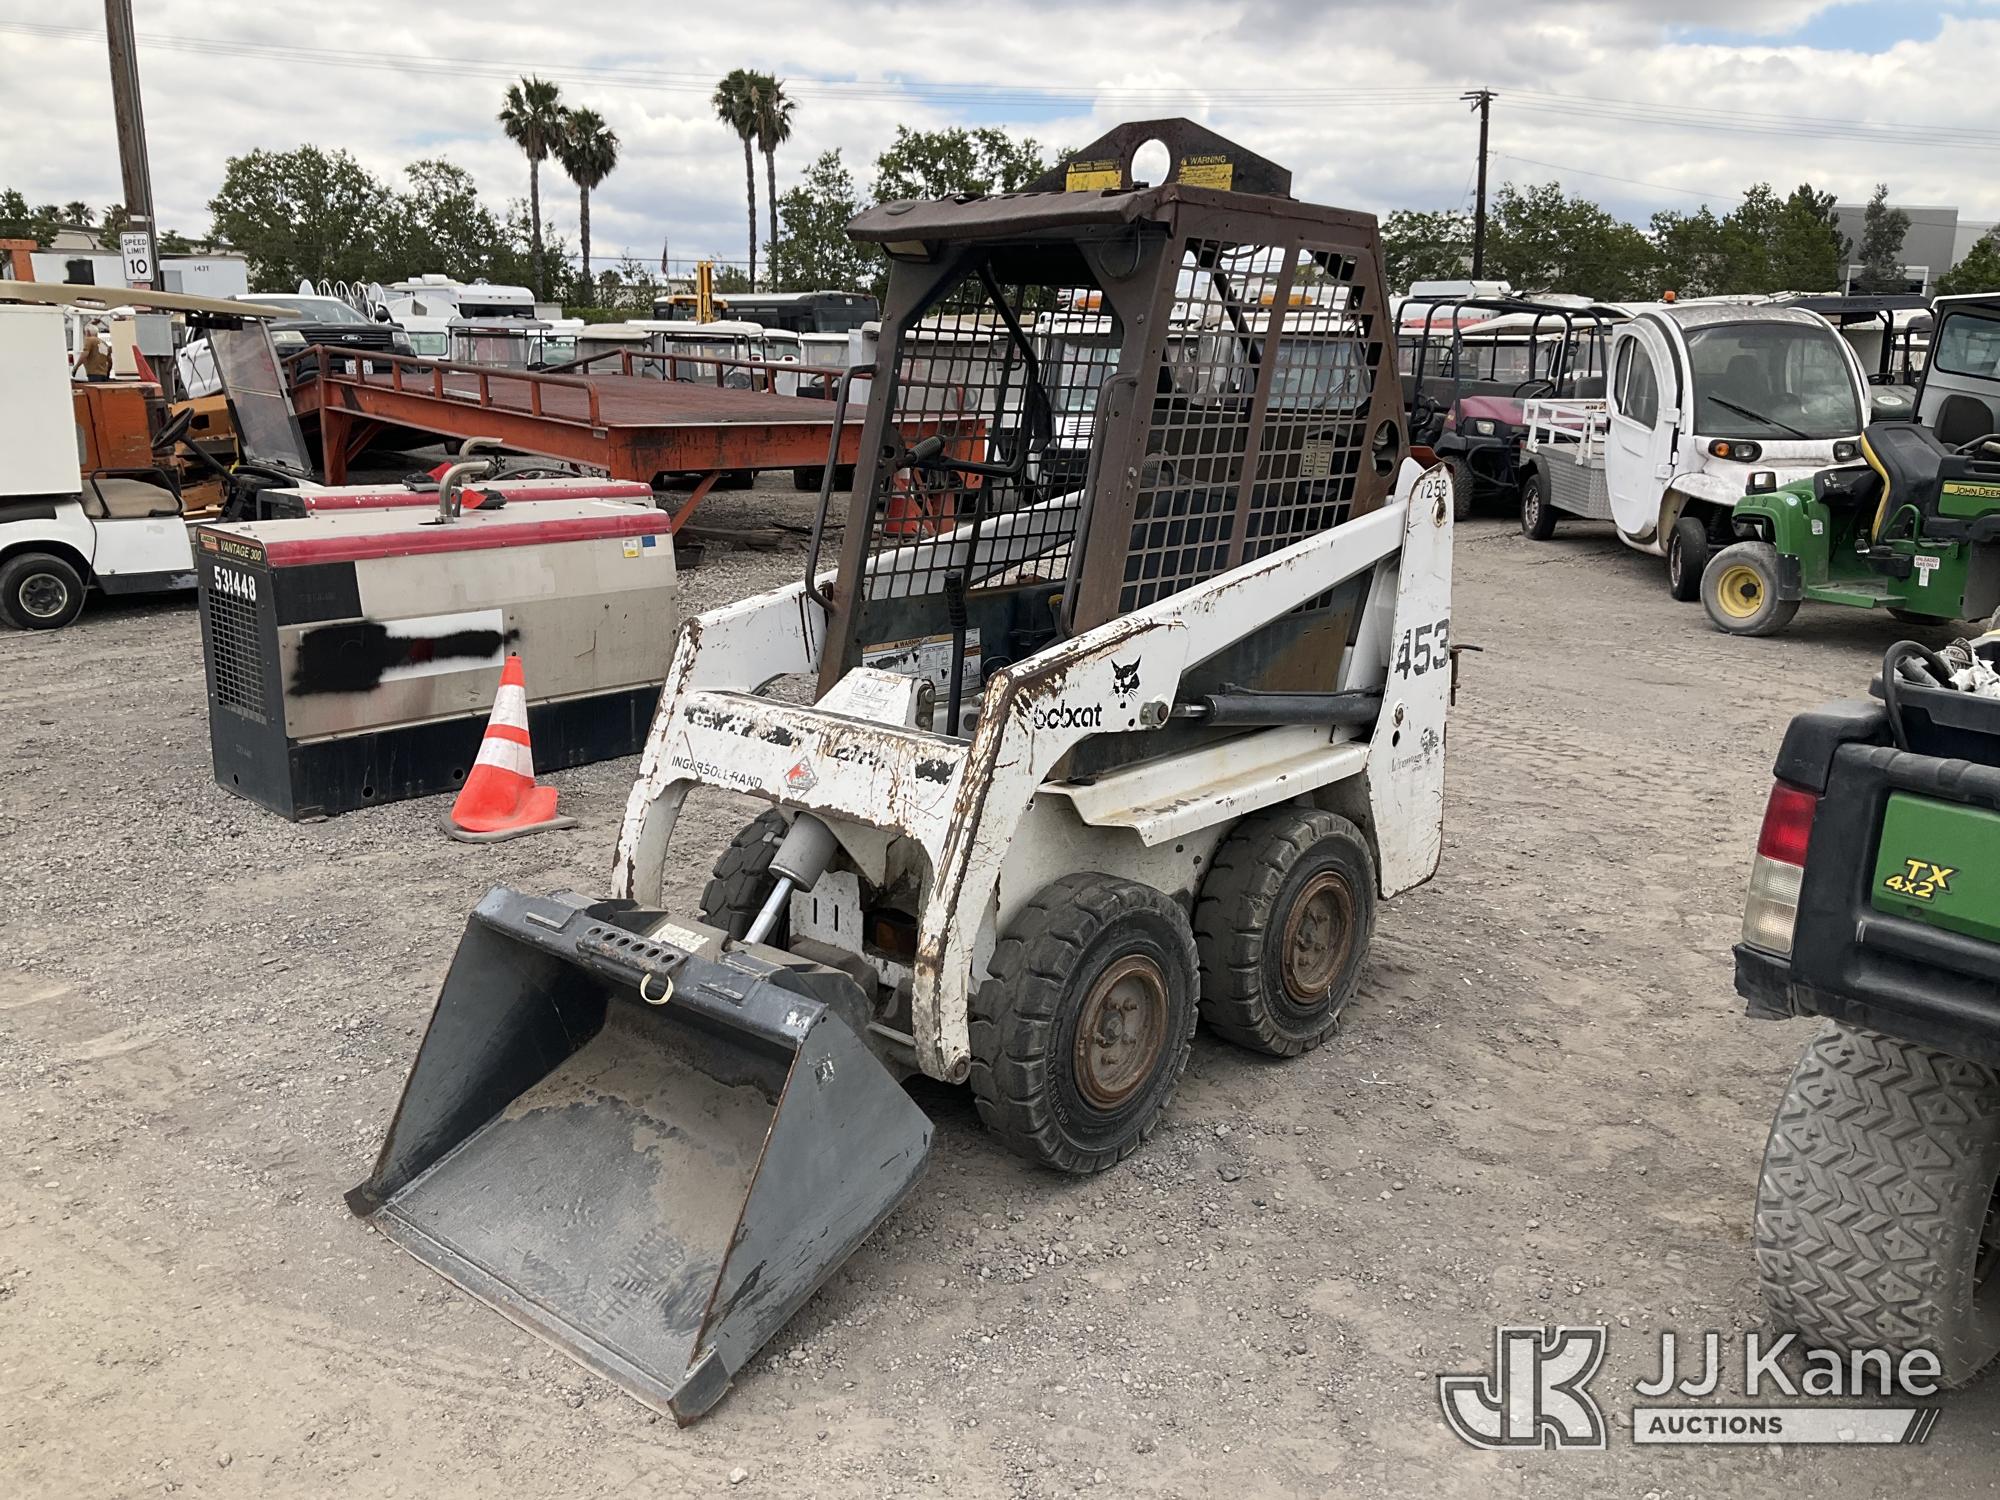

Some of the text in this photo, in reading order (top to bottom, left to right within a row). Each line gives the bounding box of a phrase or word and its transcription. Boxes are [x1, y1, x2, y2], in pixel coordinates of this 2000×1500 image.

[1190, 155, 1227, 165] WARNING
[127, 247, 146, 255] LIMIT
[129, 259, 148, 275] 10
[1954, 485, 1978, 496] JOHN
[220, 540, 250, 558] VANTAGE
[249, 549, 262, 561] 300
[1394, 618, 1450, 680] 453
[1033, 699, 1103, 730] bobcat
[1906, 859, 1955, 889] TX
[1885, 874, 1936, 898] 4x2
